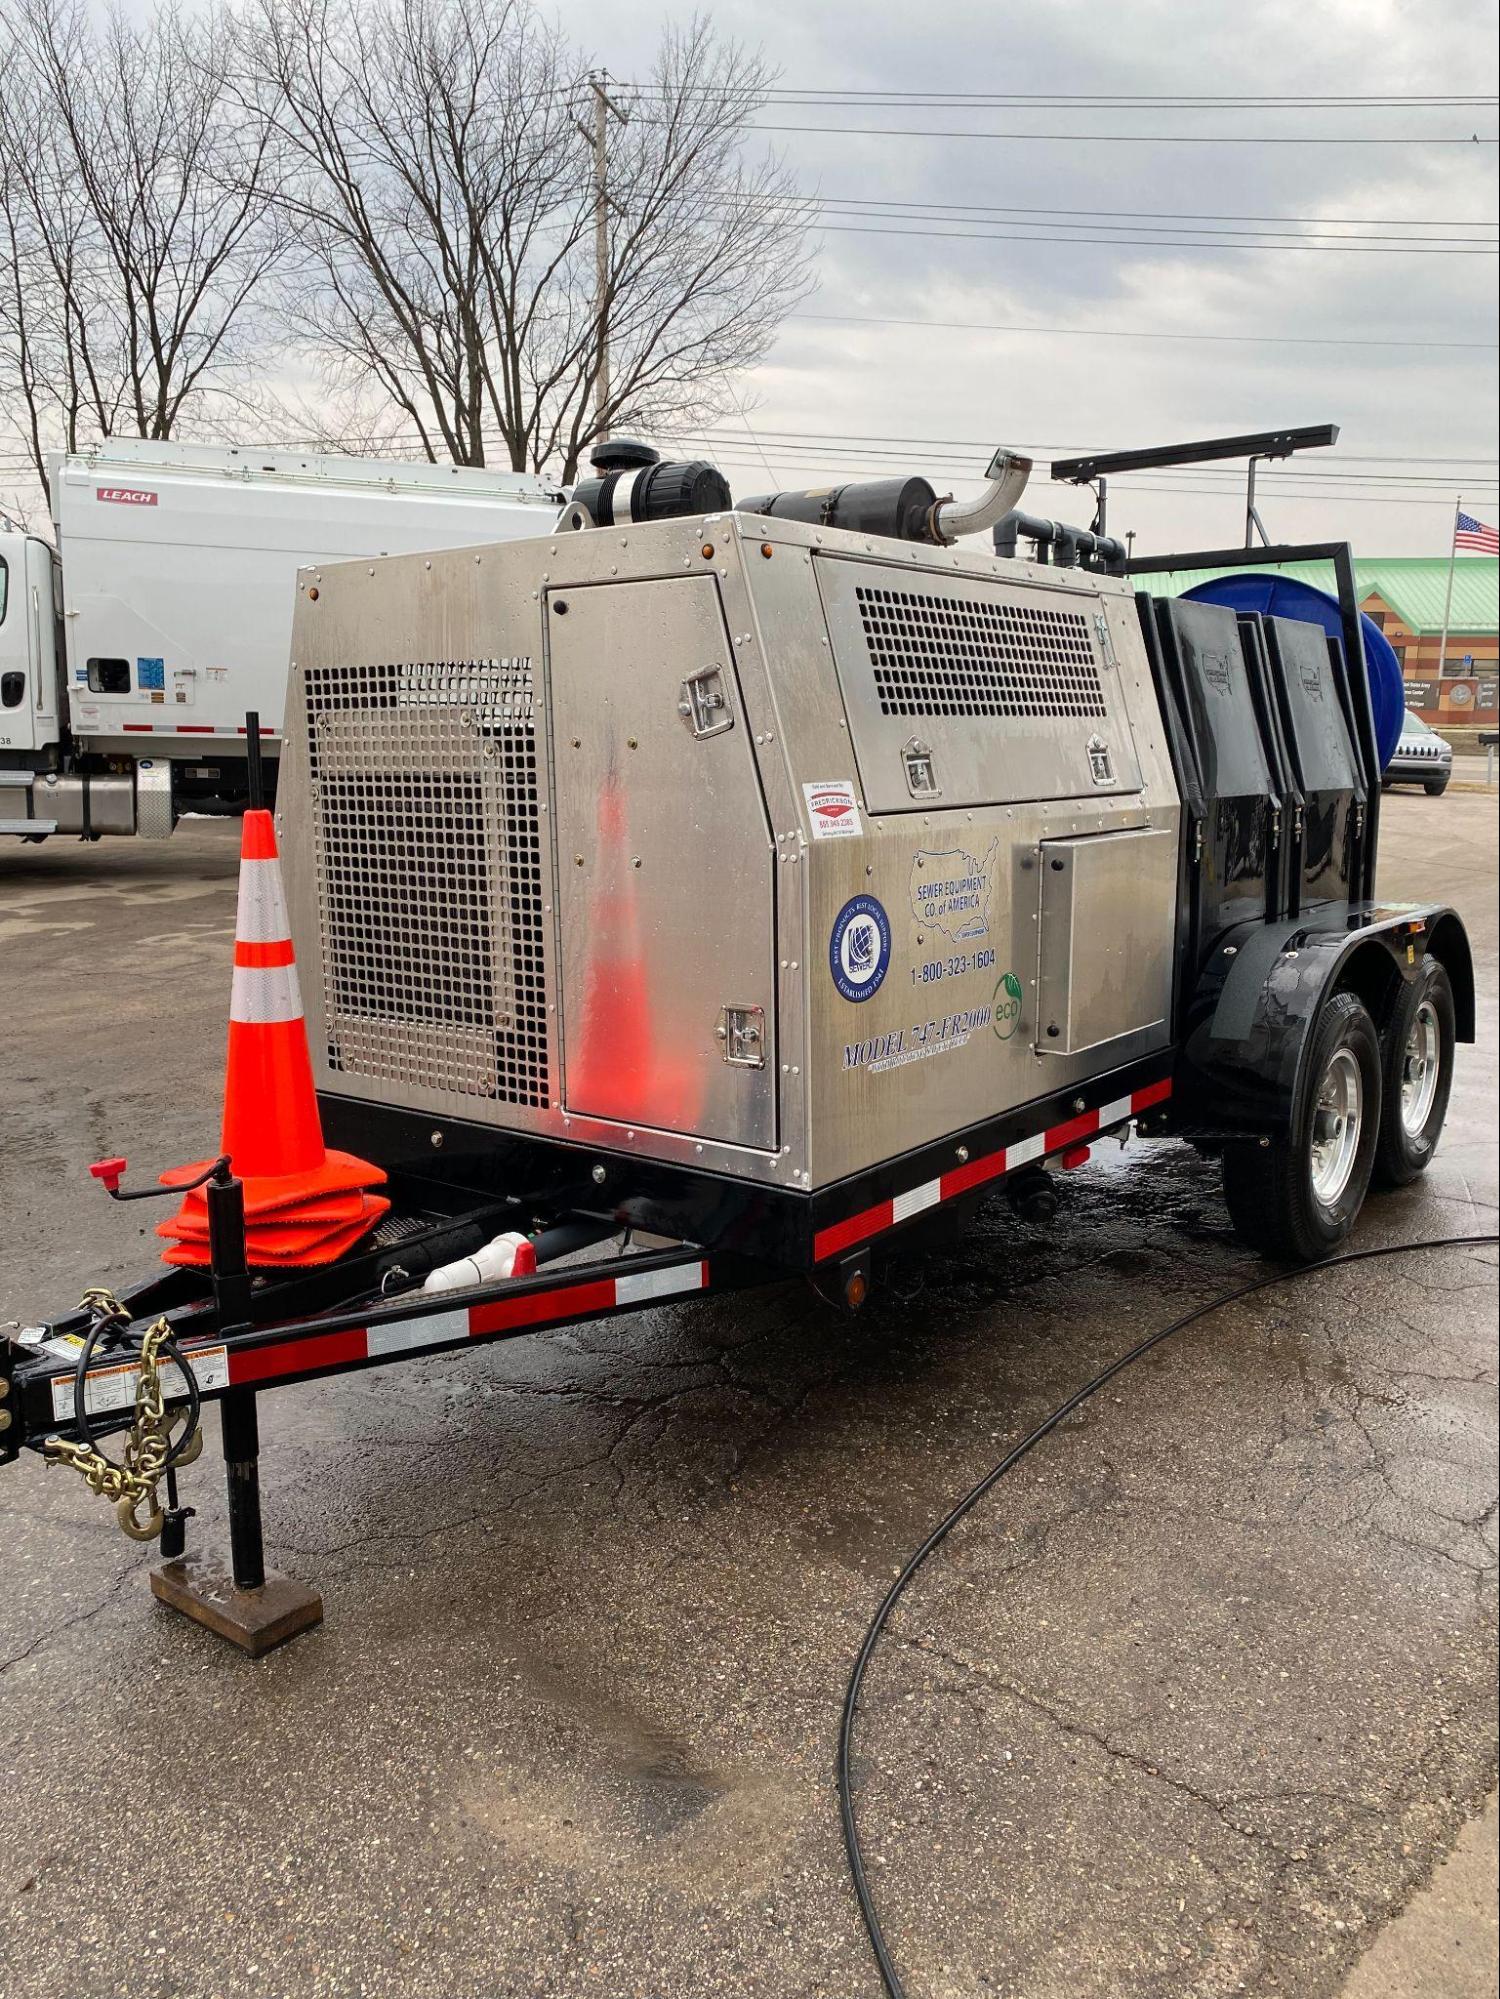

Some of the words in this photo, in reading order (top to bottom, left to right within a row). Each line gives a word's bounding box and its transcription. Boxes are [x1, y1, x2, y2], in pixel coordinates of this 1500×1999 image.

[103, 490, 151, 503] LEACH
[810, 797, 853, 807] FREDRICKSON
[917, 883, 943, 900] SEWER
[945, 875, 986, 896] EQUIPMENT
[939, 900, 946, 915] of
[949, 894, 980, 911] AMERICA
[911, 948, 996, 985] 1-800-323-1604
[838, 977, 873, 998] ESTABLISHED
[996, 1000, 1018, 1021] eco
[842, 1030, 907, 1070] MODEL
[911, 1004, 992, 1050] 747-FR2000
